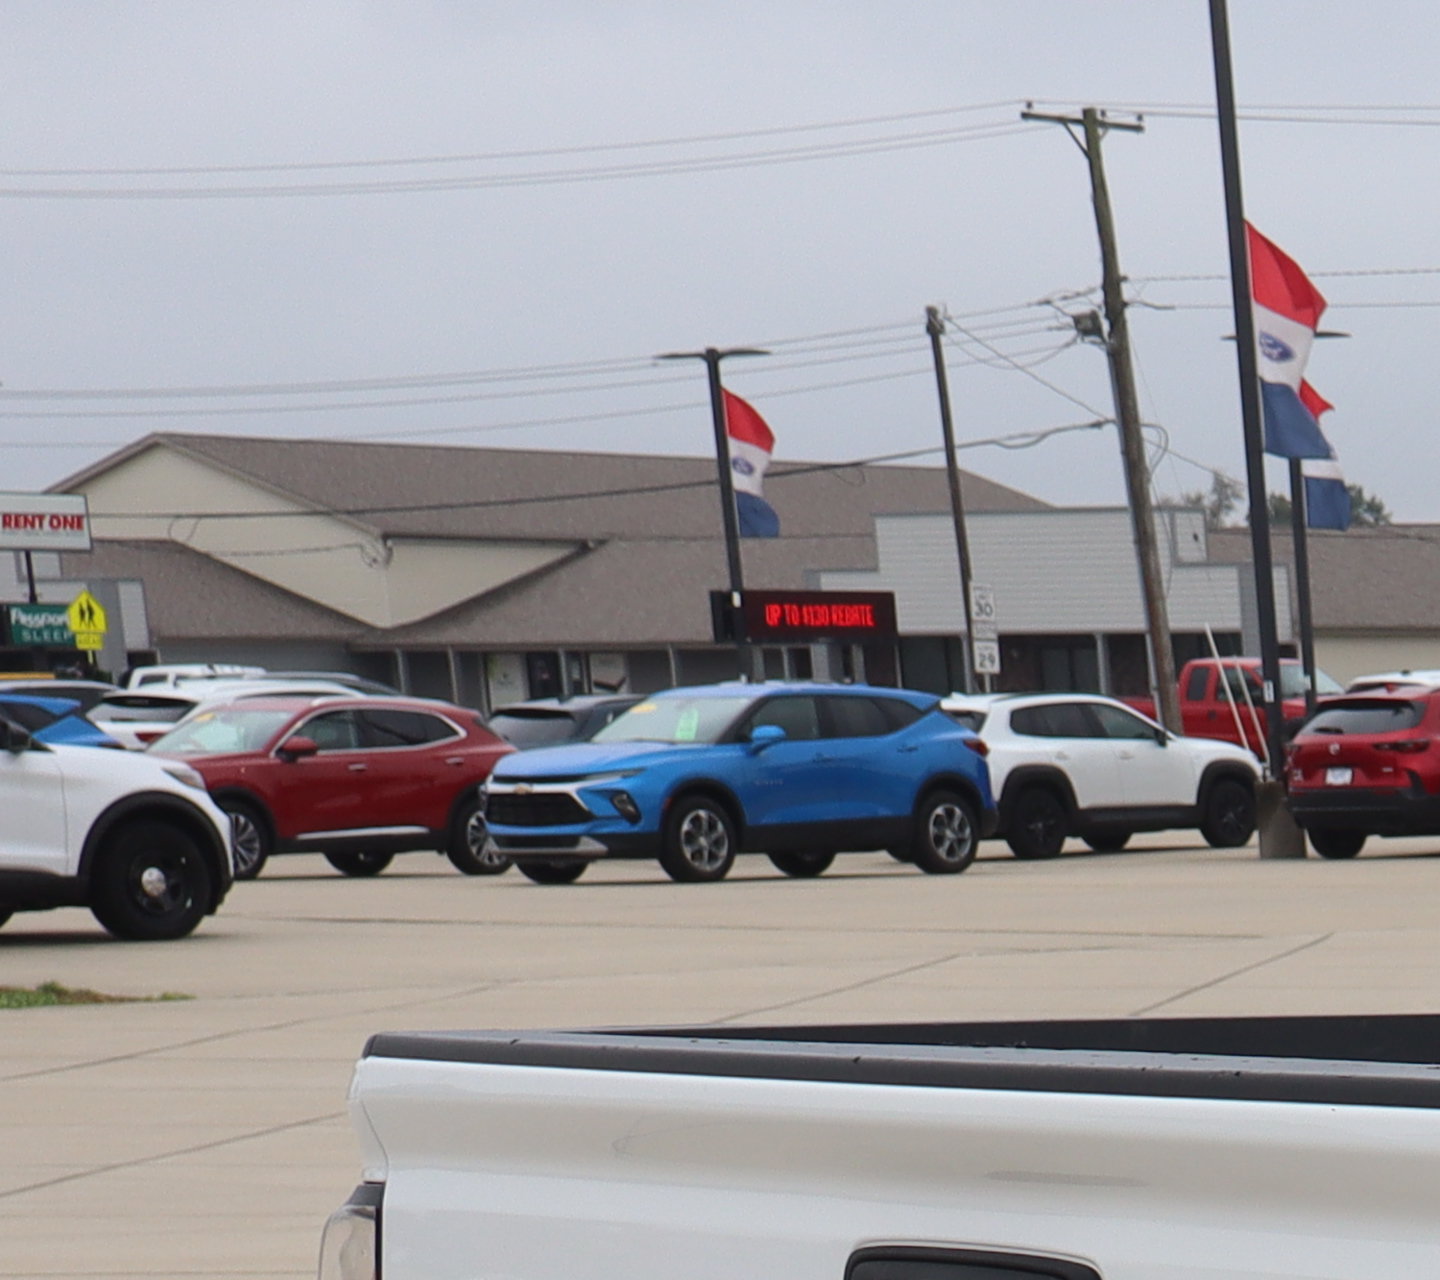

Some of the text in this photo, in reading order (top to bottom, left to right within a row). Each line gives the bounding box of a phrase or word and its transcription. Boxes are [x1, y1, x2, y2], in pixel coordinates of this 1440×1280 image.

[2, 513, 84, 531] RENT ONE
[765, 604, 781, 626] UP
[784, 604, 800, 626] TO
[975, 602, 993, 618] 30
